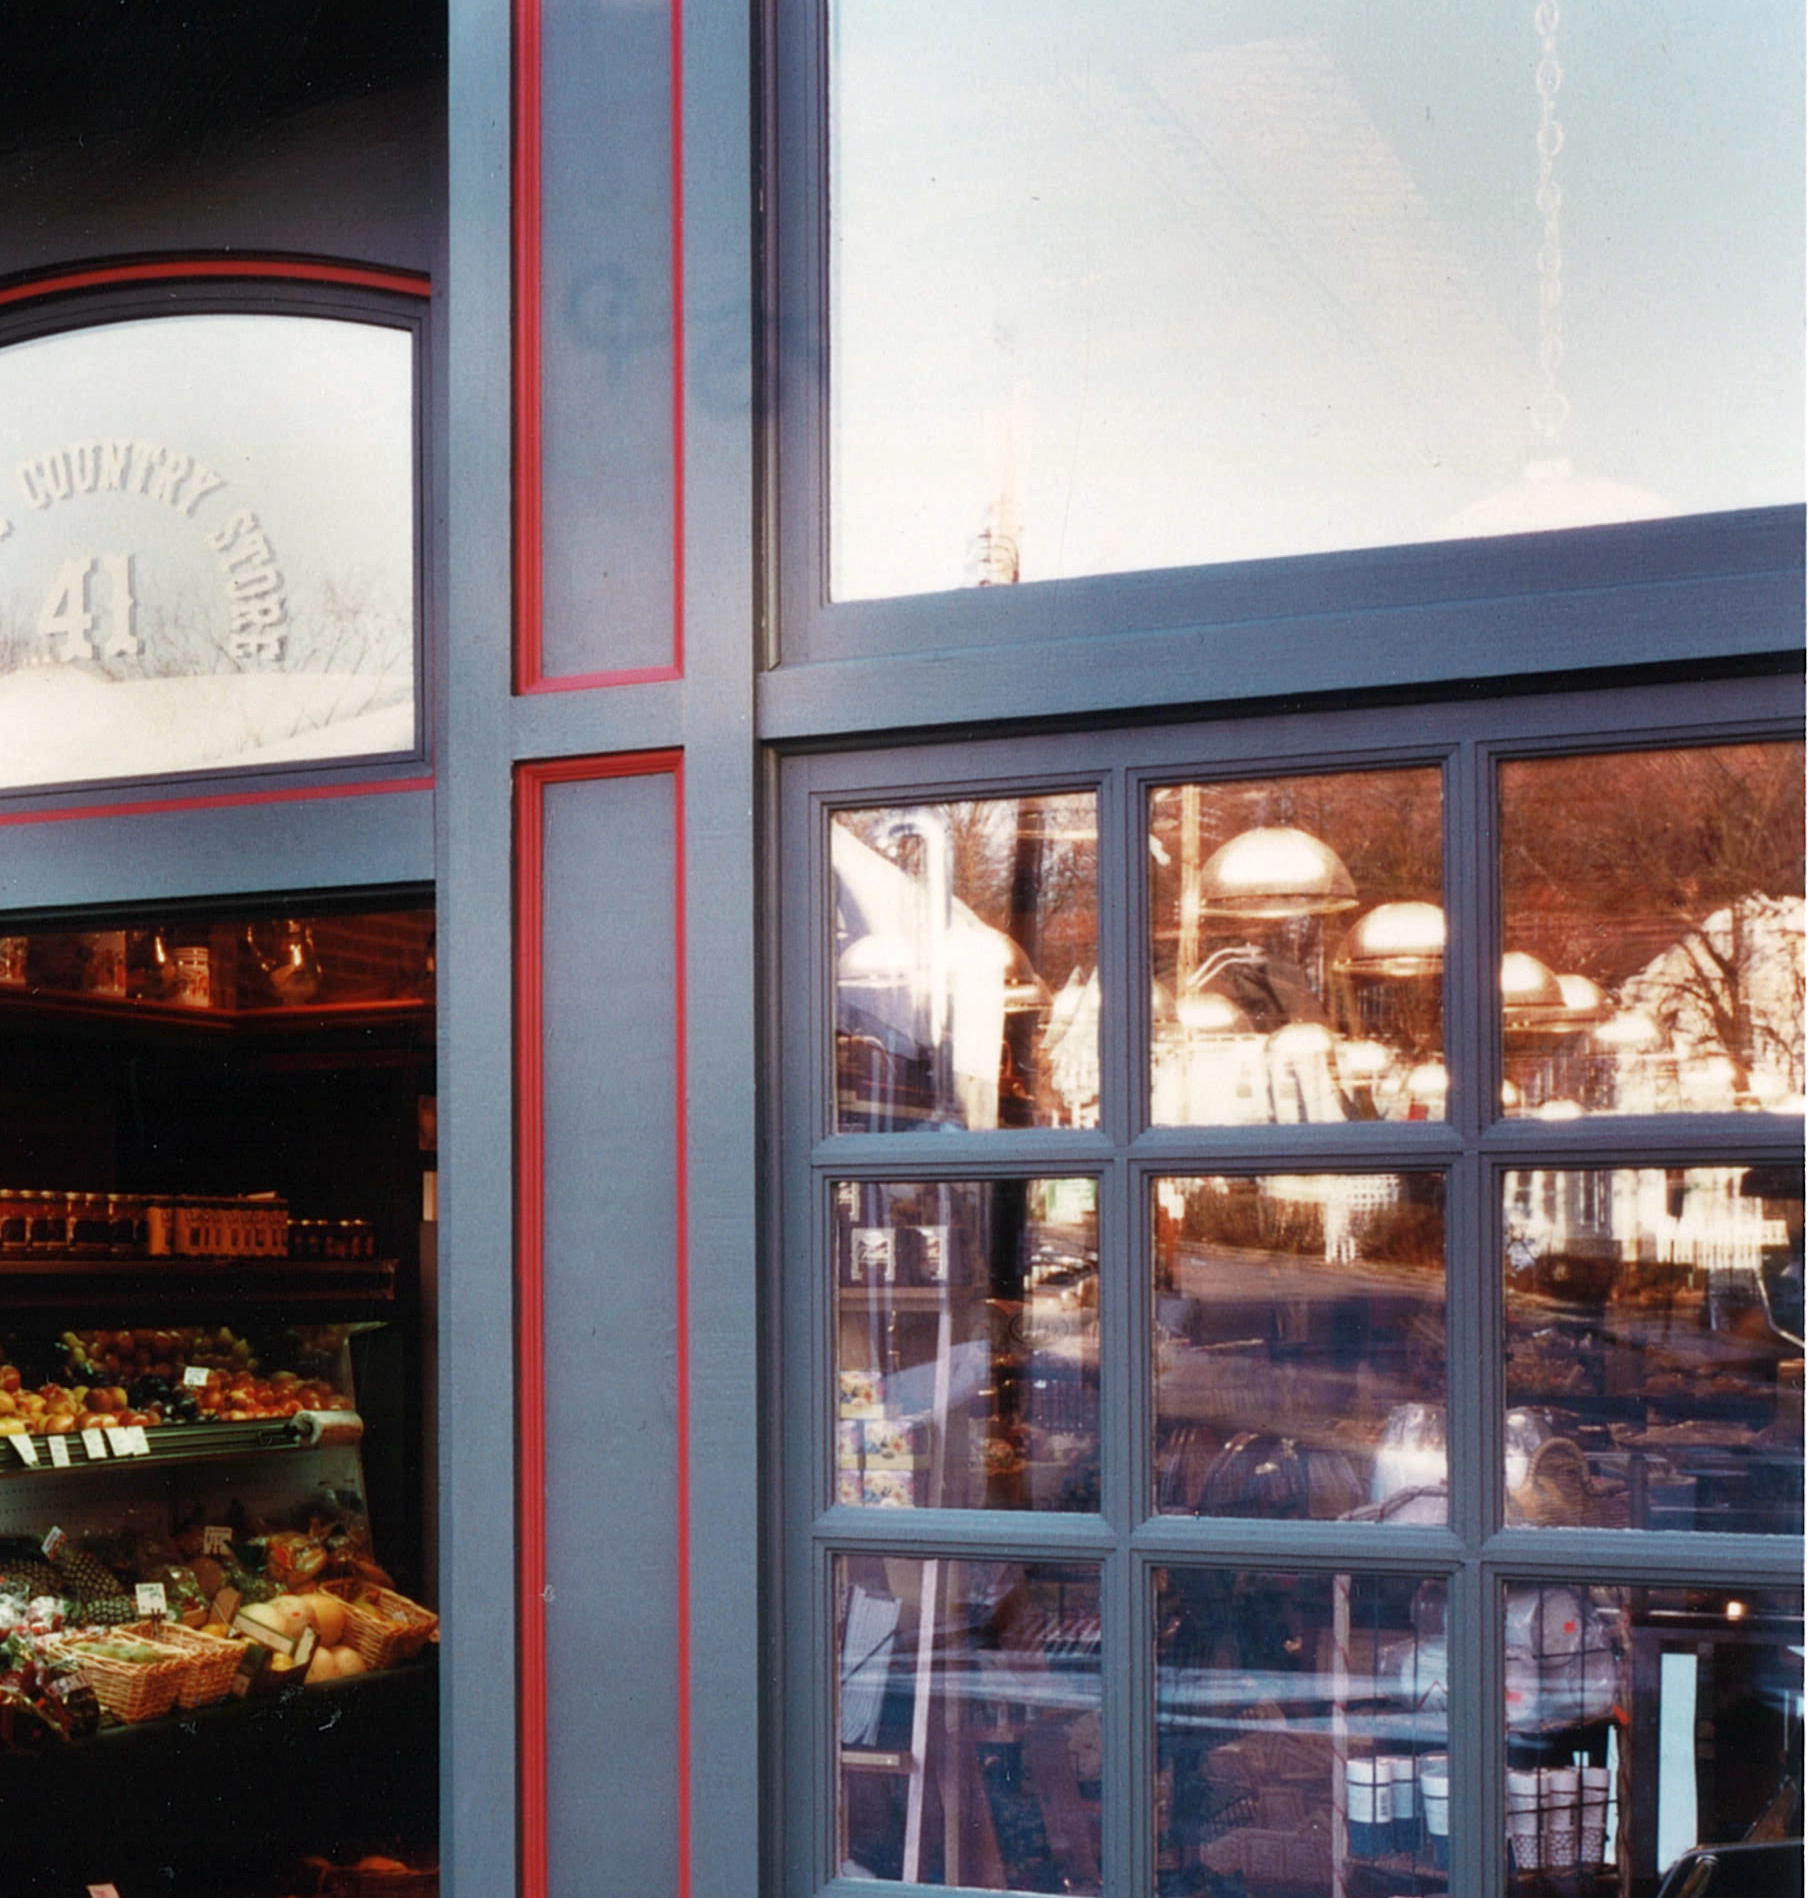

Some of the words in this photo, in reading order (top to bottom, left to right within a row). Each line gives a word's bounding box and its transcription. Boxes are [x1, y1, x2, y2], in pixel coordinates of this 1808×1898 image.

[16, 438, 226, 517] COUNTRY
[209, 507, 290, 666] STORE
[36, 552, 144, 663] 41
